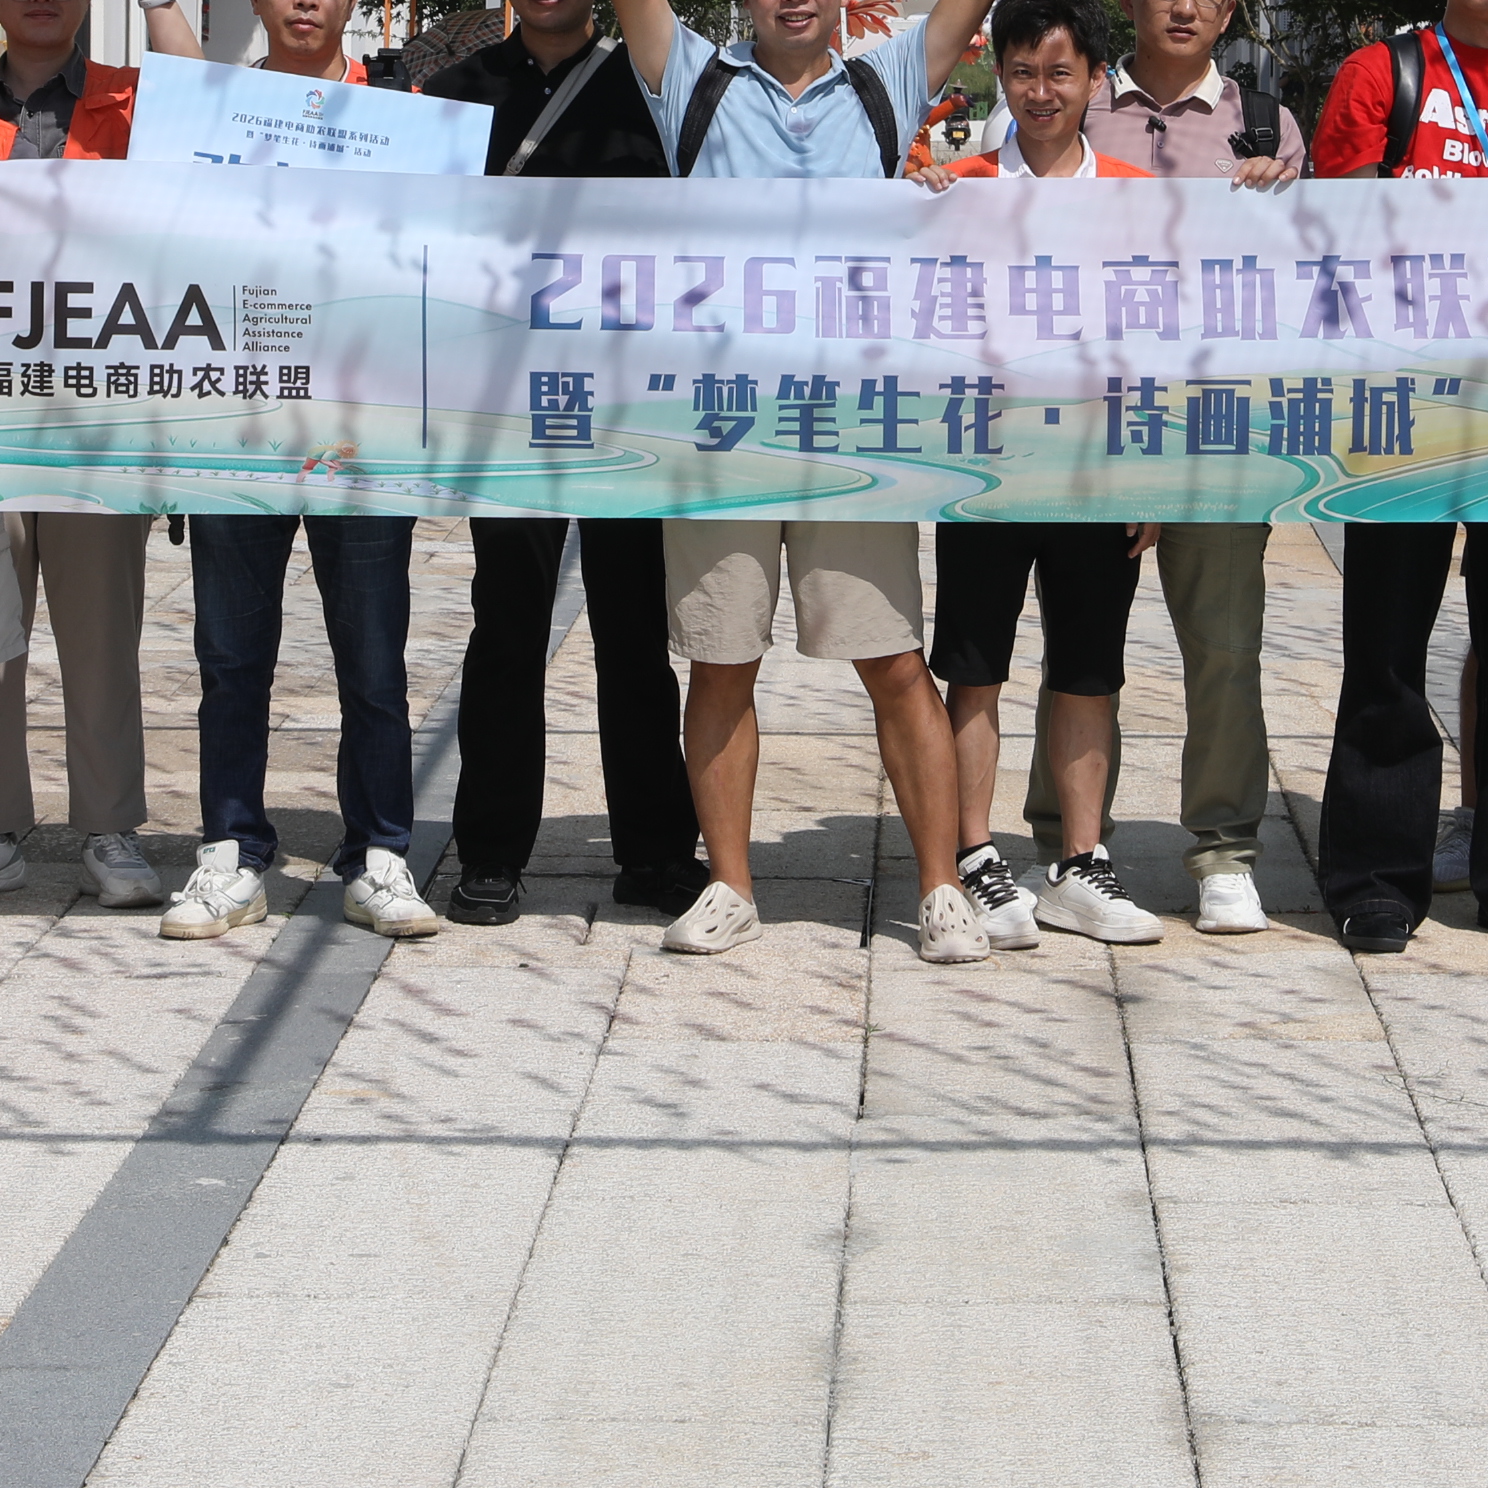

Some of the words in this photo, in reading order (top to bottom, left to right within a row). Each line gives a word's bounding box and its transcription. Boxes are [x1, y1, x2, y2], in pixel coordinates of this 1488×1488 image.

[242, 285, 277, 298] Fujian
[242, 300, 312, 311] E-commerce
[242, 314, 312, 326] Agricultural
[242, 327, 303, 339] Assistance
[242, 342, 290, 352] Alliance
